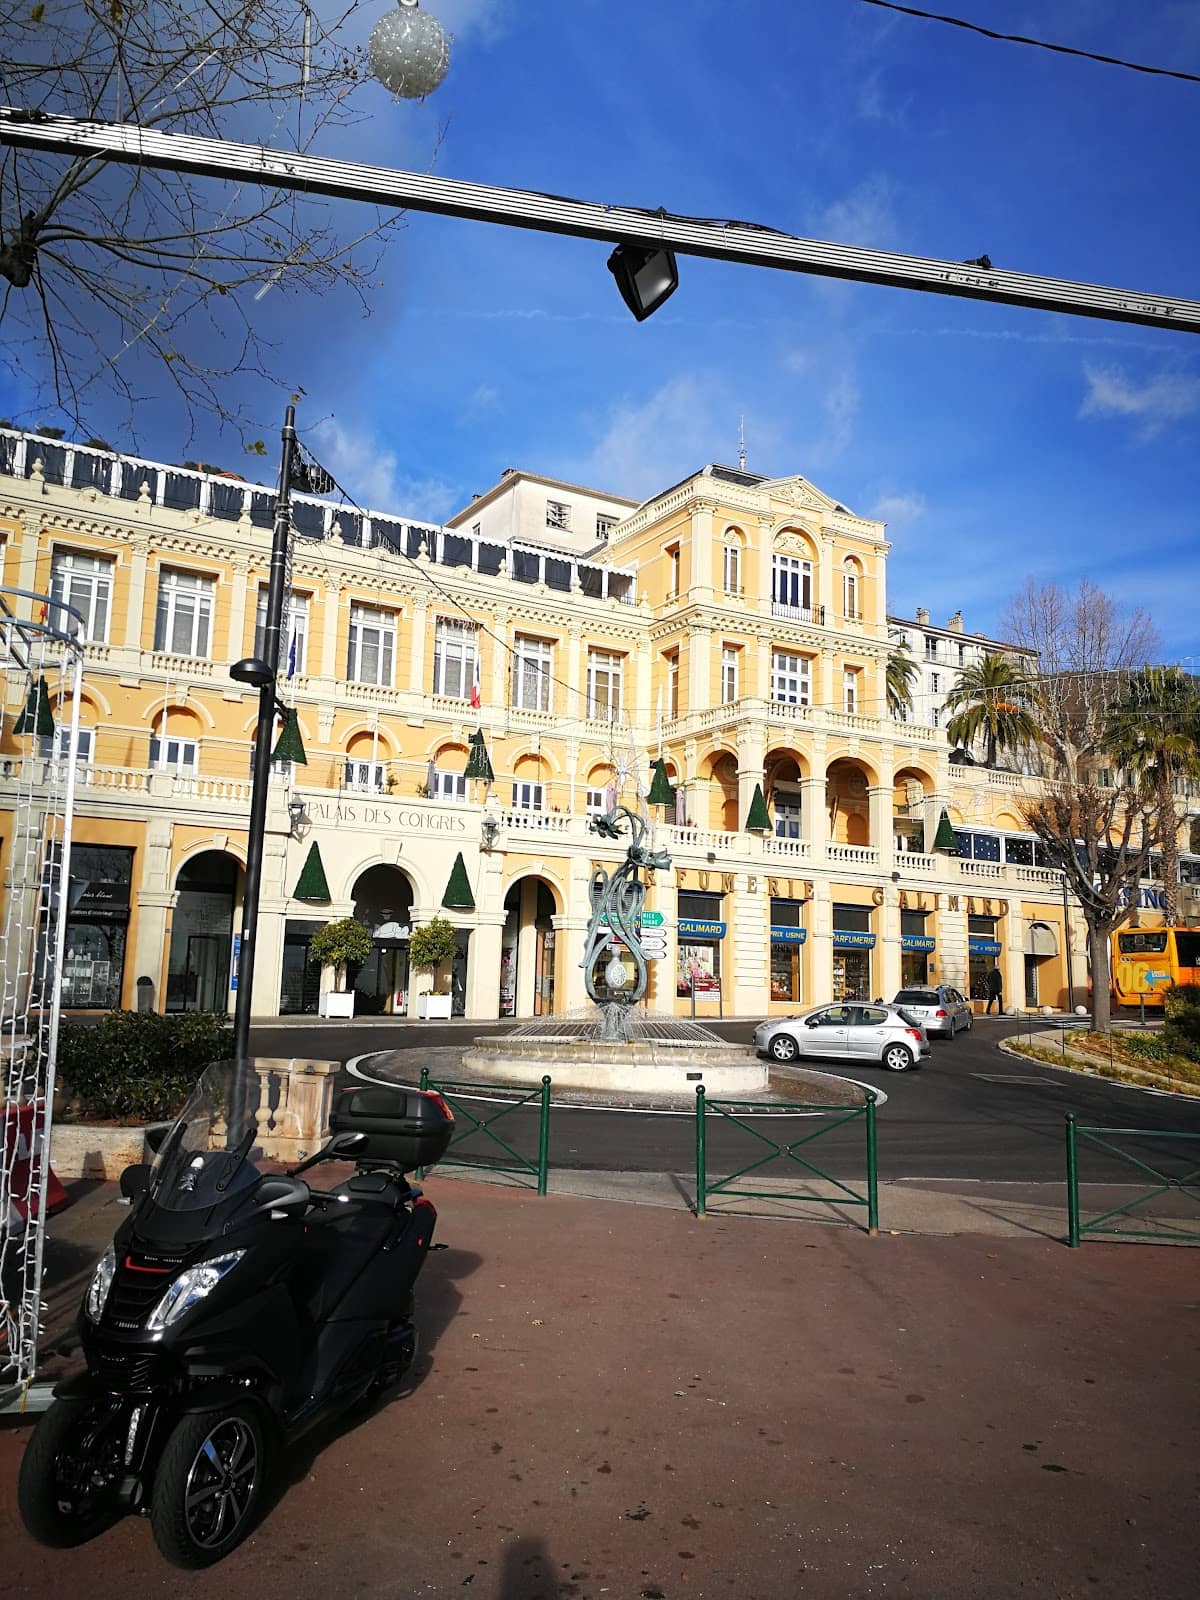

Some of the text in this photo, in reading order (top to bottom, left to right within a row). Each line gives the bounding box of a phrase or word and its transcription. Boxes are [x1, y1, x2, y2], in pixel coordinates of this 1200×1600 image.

[307, 801, 466, 832] PALAIS DES CONGRES
[593, 862, 1009, 916] RFUMERIE GALIMARD
[679, 922, 722, 934] GALIMARD
[902, 939, 935, 948] GALIMARD
[1119, 962, 1149, 993] 06
